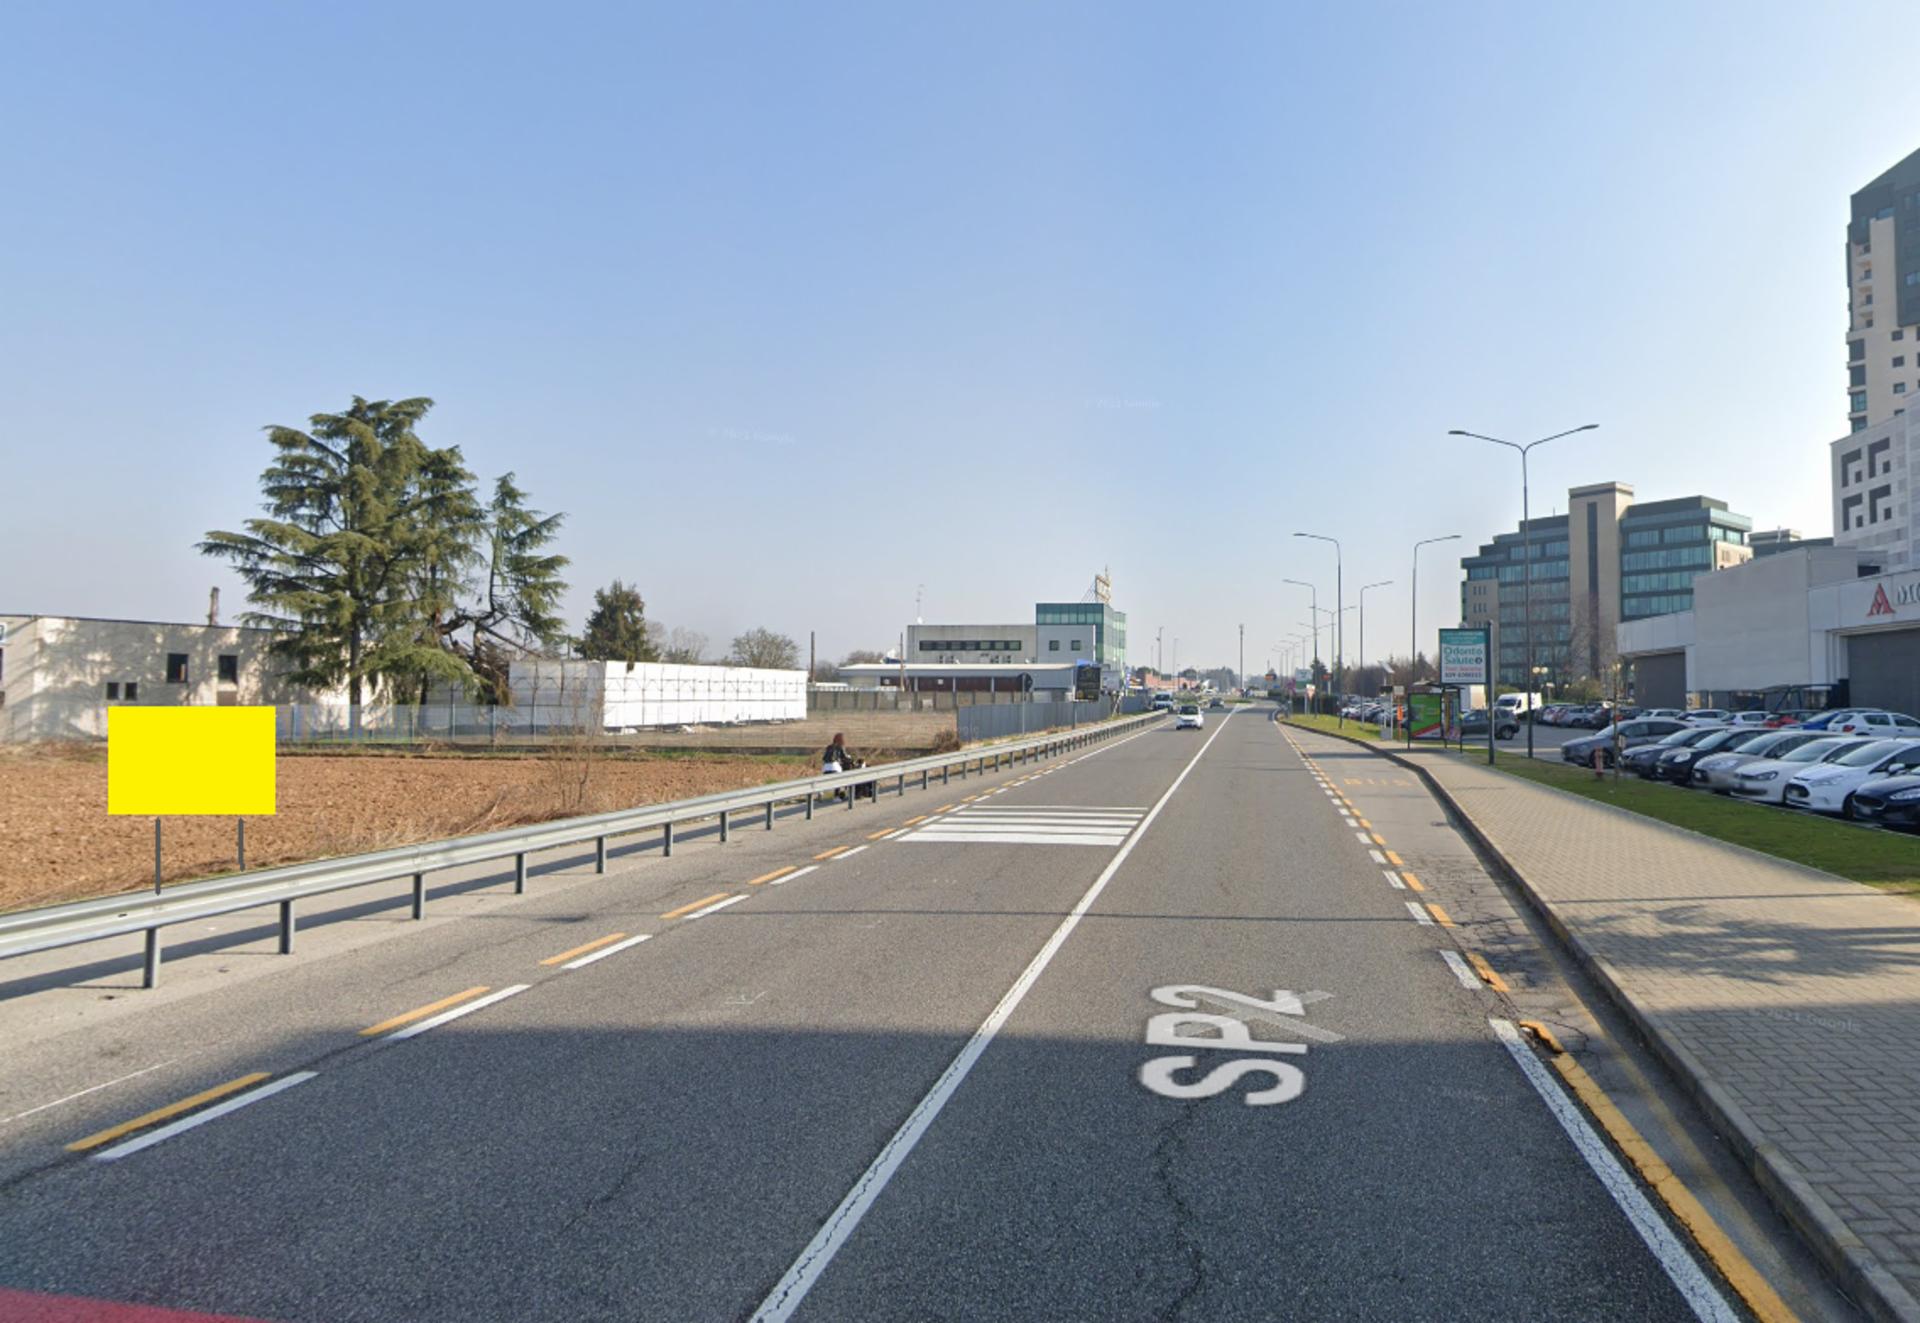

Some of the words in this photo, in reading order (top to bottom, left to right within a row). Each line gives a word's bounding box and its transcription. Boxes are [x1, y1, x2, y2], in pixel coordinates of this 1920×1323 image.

[1444, 646, 1483, 656] Odonto
[1444, 656, 1474, 665] Salute
[1140, 984, 1308, 1106] SP2
